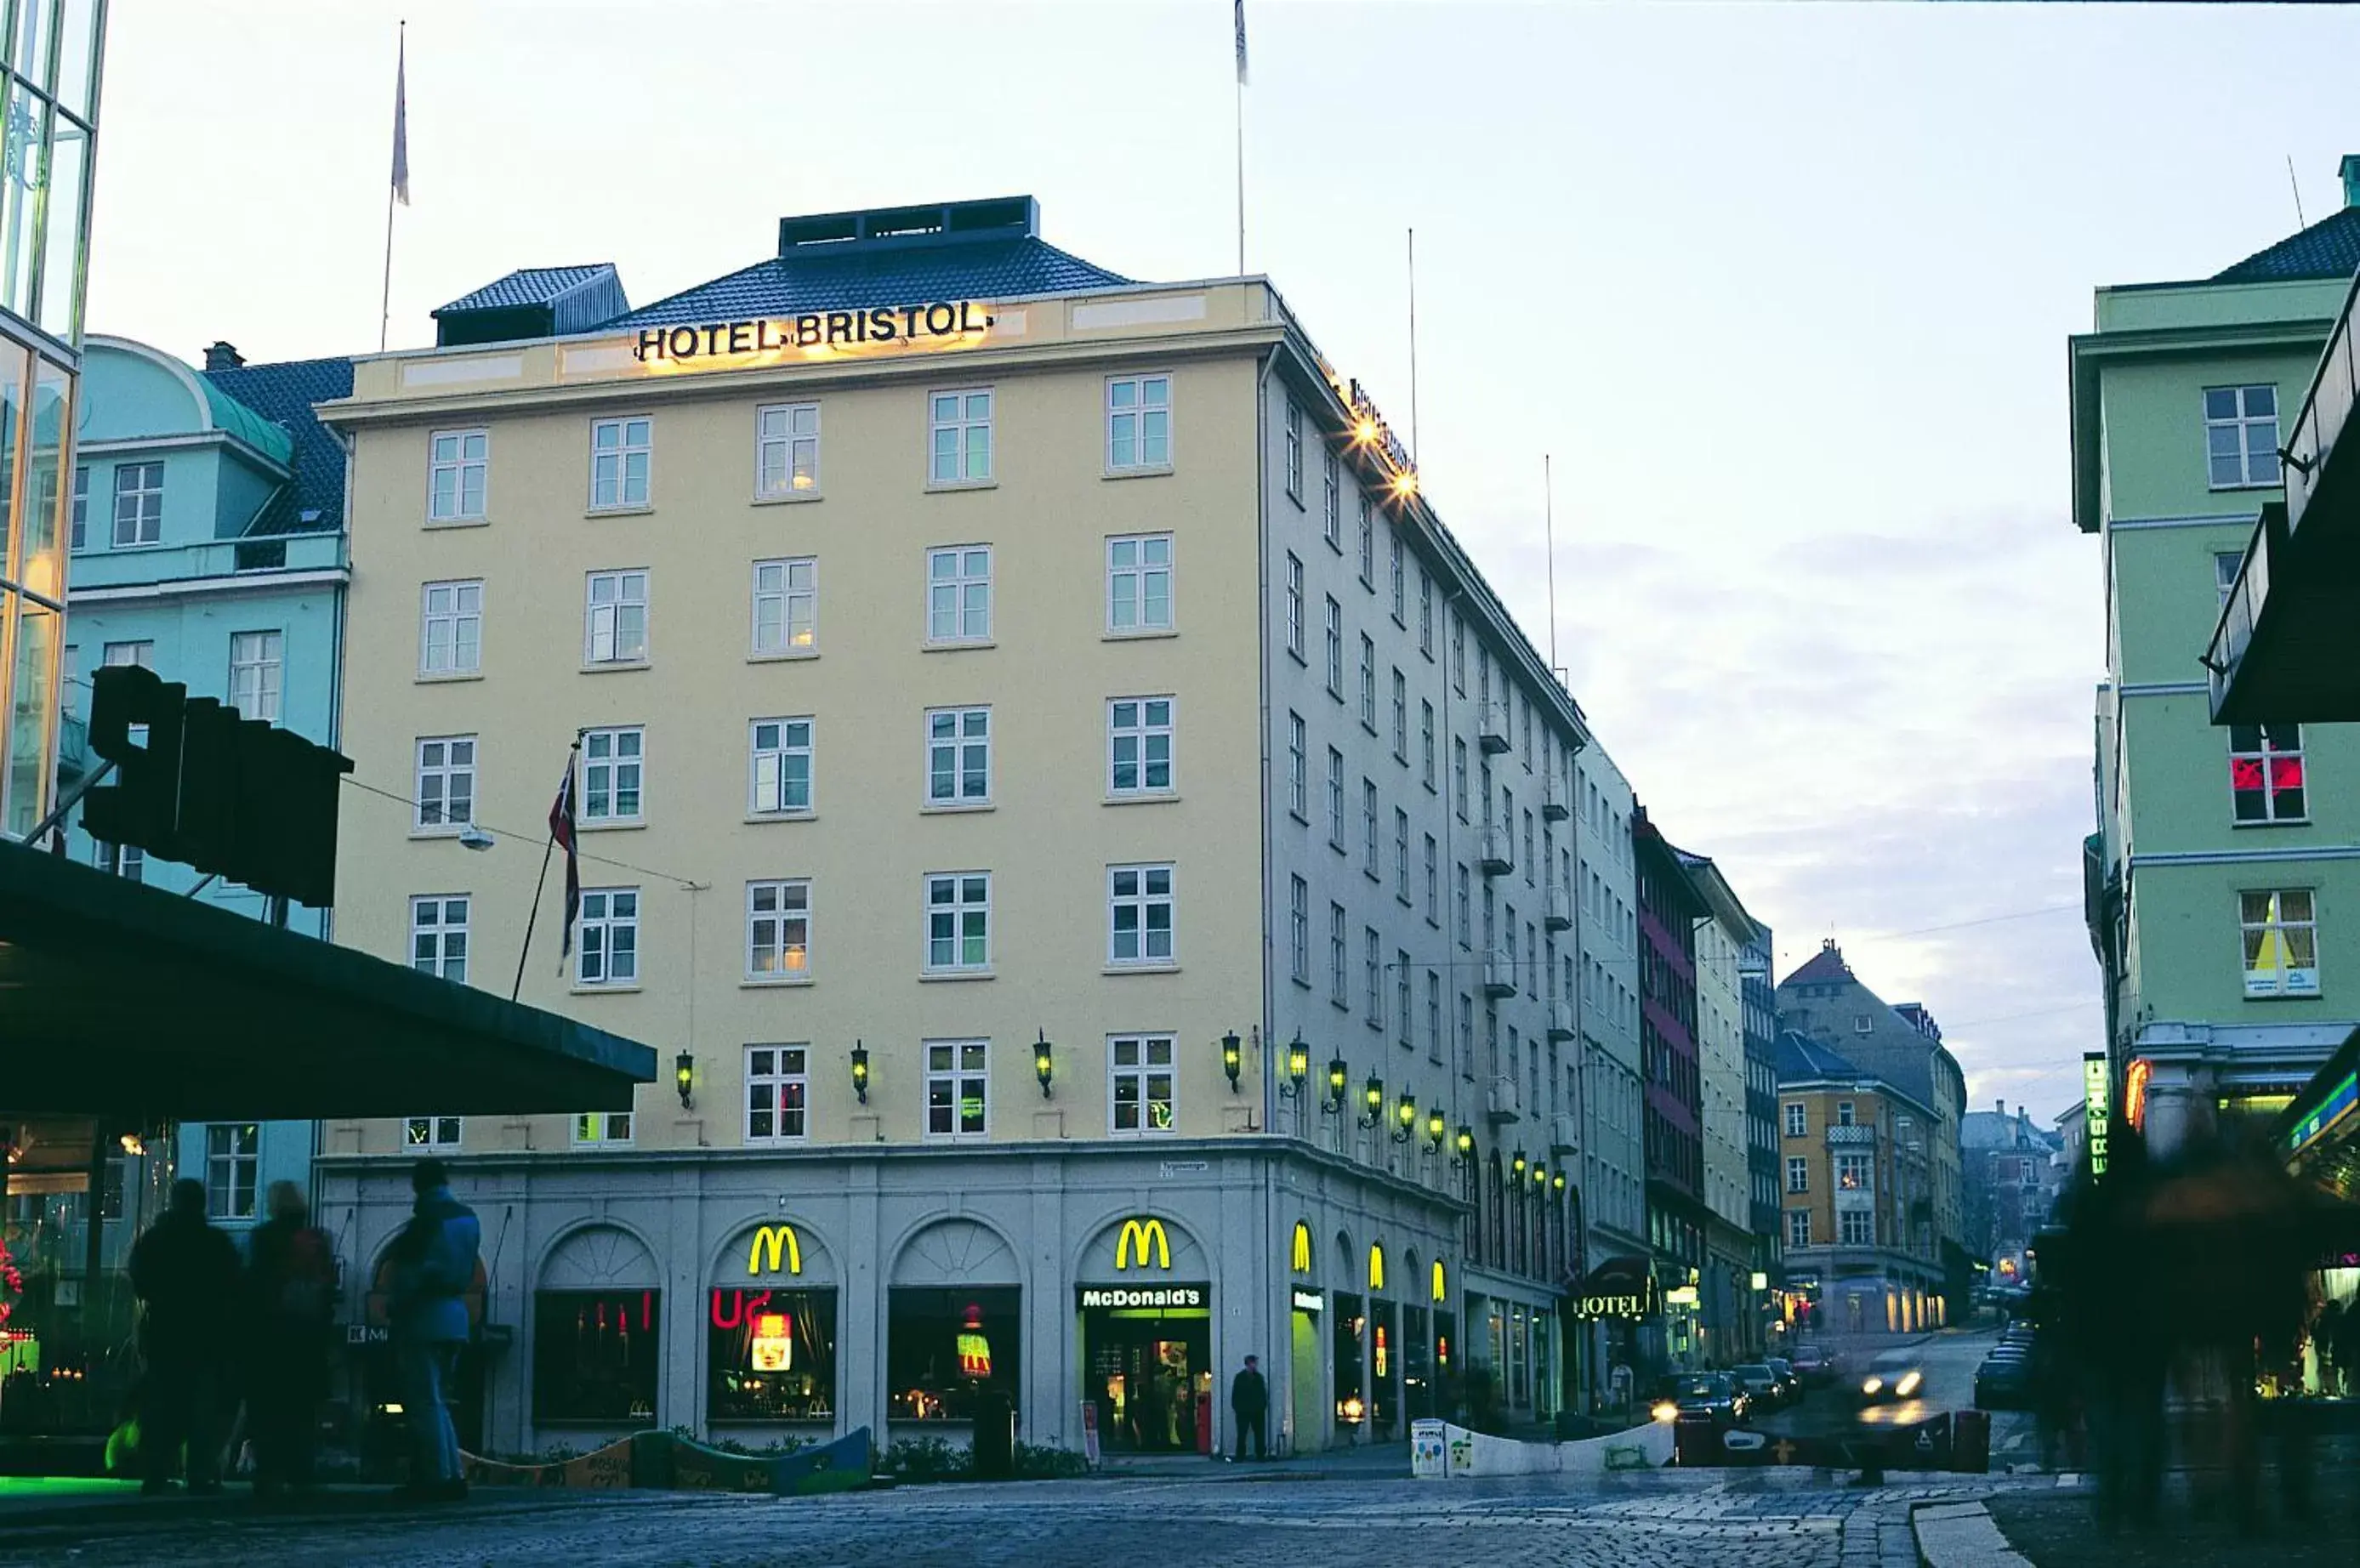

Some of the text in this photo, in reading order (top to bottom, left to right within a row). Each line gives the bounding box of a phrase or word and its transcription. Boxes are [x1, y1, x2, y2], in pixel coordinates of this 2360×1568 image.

[639, 301, 985, 361] HOTEL BRISTOL
[1083, 1289, 1200, 1306] McDonald's
[1573, 1295, 1644, 1315] HOTEL
